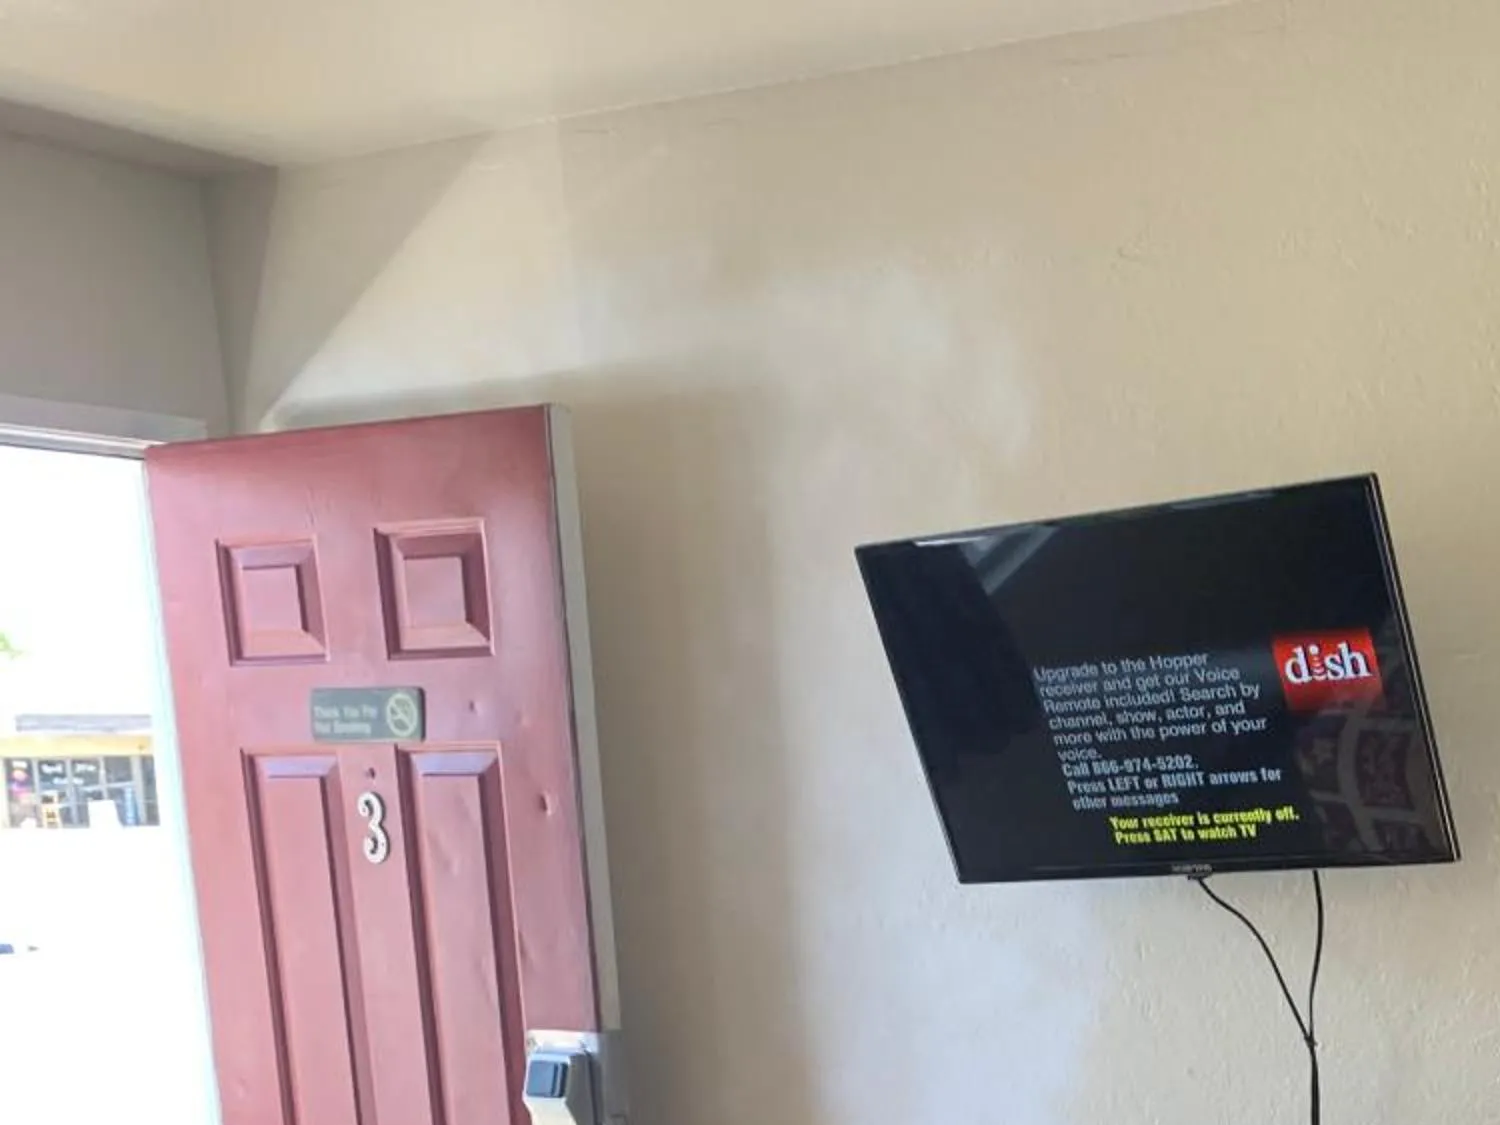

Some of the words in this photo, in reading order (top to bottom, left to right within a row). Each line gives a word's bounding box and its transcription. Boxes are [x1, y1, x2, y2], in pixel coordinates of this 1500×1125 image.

[1033, 661, 1098, 683] Upgrade
[1101, 661, 1118, 674] to
[1120, 658, 1146, 673] the
[1148, 654, 1208, 671] Hopper
[1284, 641, 1373, 684] dish
[1040, 681, 1098, 697] receiver
[1103, 678, 1132, 692] and
[1136, 674, 1160, 692] get
[1164, 674, 1189, 686] our
[1193, 667, 1240, 683] Voice
[1043, 699, 1101, 713] Remote
[1179, 684, 1237, 702] Search
[1239, 682, 1260, 700] by
[1048, 712, 1113, 730] channel,
[1115, 709, 1163, 725] show,
[1165, 705, 1211, 721] actor,
[1214, 699, 1246, 716] and
[1053, 732, 1093, 746] more
[1095, 727, 1127, 743] with
[1128, 725, 1155, 740] the
[1159, 723, 1207, 742] power
[1211, 718, 1227, 734] of
[1230, 718, 1267, 736] your
[1057, 748, 1103, 762] voice.
[1062, 761, 1091, 778] Call
[1067, 780, 1107, 795] Press
[1107, 776, 1140, 792] LEFT
[1143, 778, 1158, 790] or
[1161, 772, 1205, 789] RIGHT
[1209, 770, 1258, 785] arrows
[1260, 767, 1281, 782] for
[1072, 796, 1107, 811] other
[1110, 793, 1179, 808] messages
[357, 791, 389, 865] 3
[1109, 815, 1139, 830] Your
[1142, 813, 1194, 829] receiver
[1196, 811, 1211, 825] is
[1213, 808, 1271, 825] currently
[1275, 806, 1299, 821] off.
[1115, 831, 1152, 845] Press
[1152, 828, 1177, 843] SAT
[1180, 828, 1195, 841] to
[1197, 825, 1237, 841] watch
[1239, 823, 1256, 838] TV
